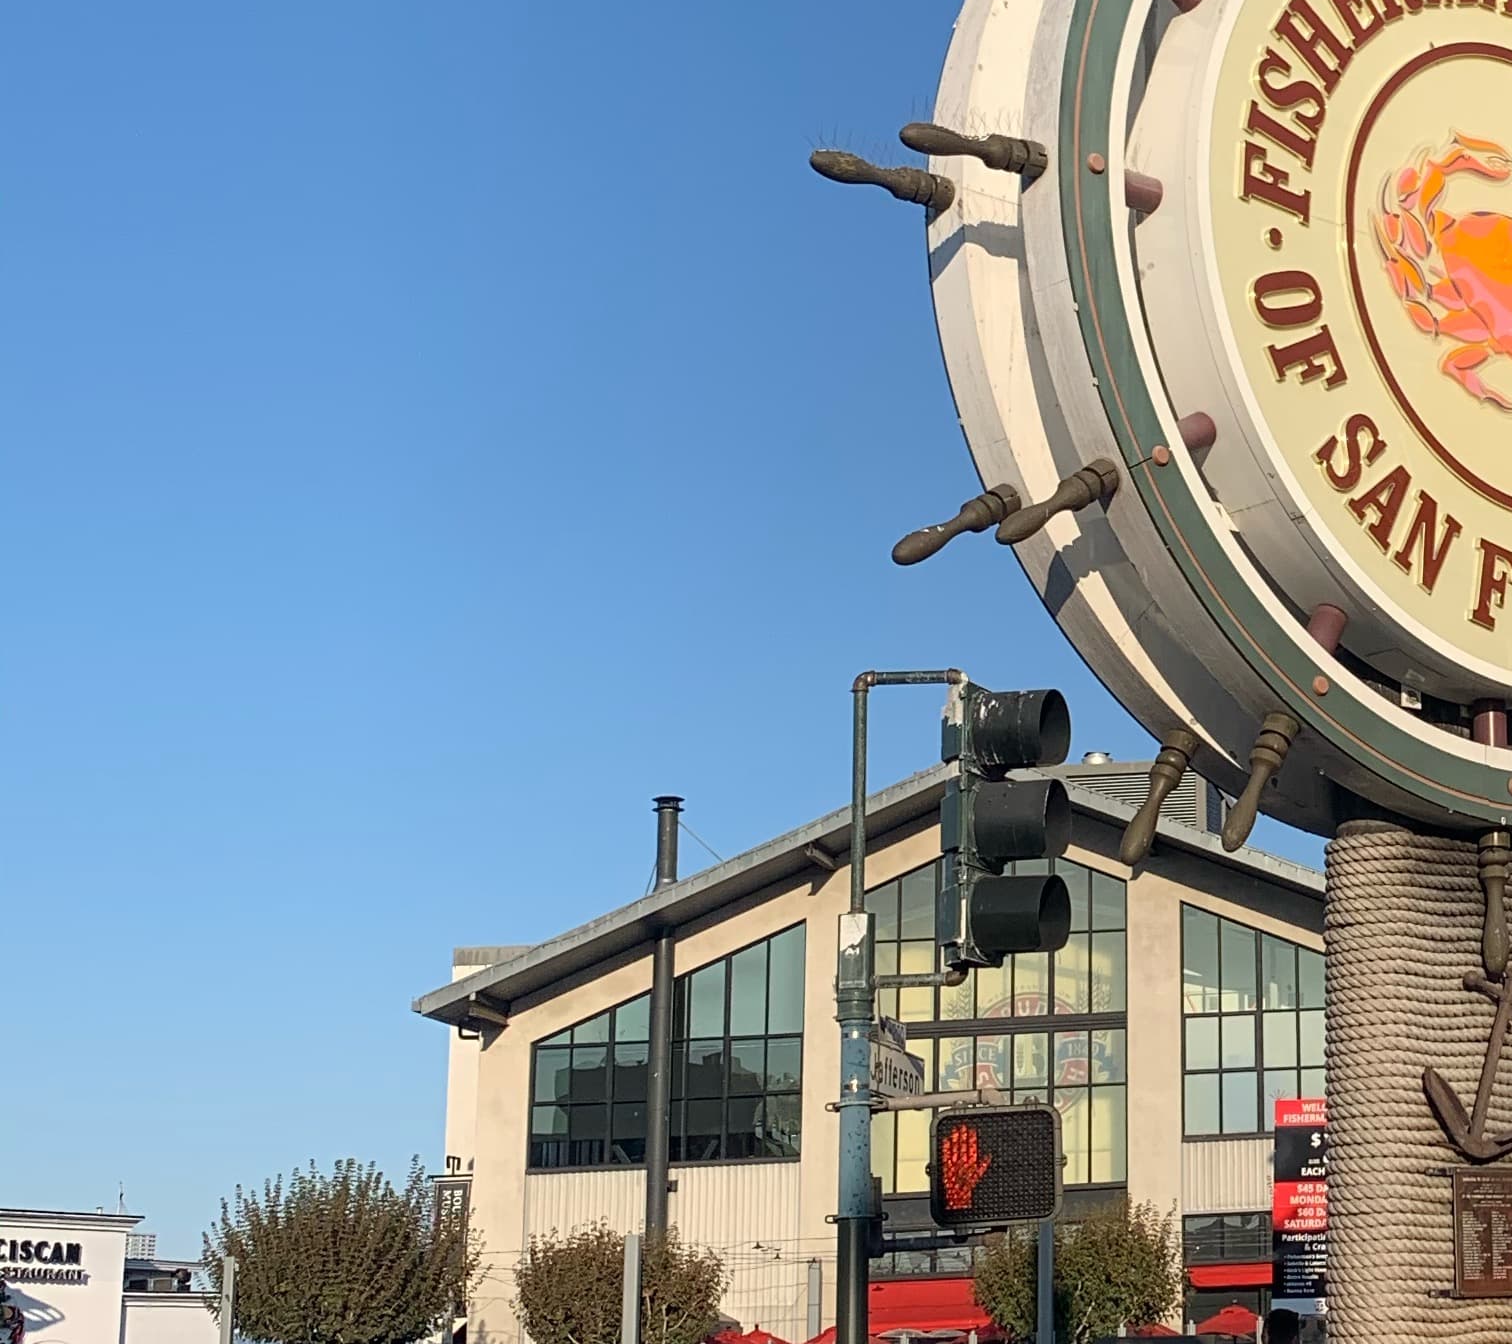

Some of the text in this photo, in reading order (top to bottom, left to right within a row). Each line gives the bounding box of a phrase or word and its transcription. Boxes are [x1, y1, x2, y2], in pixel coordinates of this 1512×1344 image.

[1249, 269, 1348, 392] OF
[1314, 412, 1464, 596] SAN
[954, 1046, 998, 1066] SICE
[1301, 1167, 1326, 1176] EACH
[1316, 1207, 1327, 1217] D
